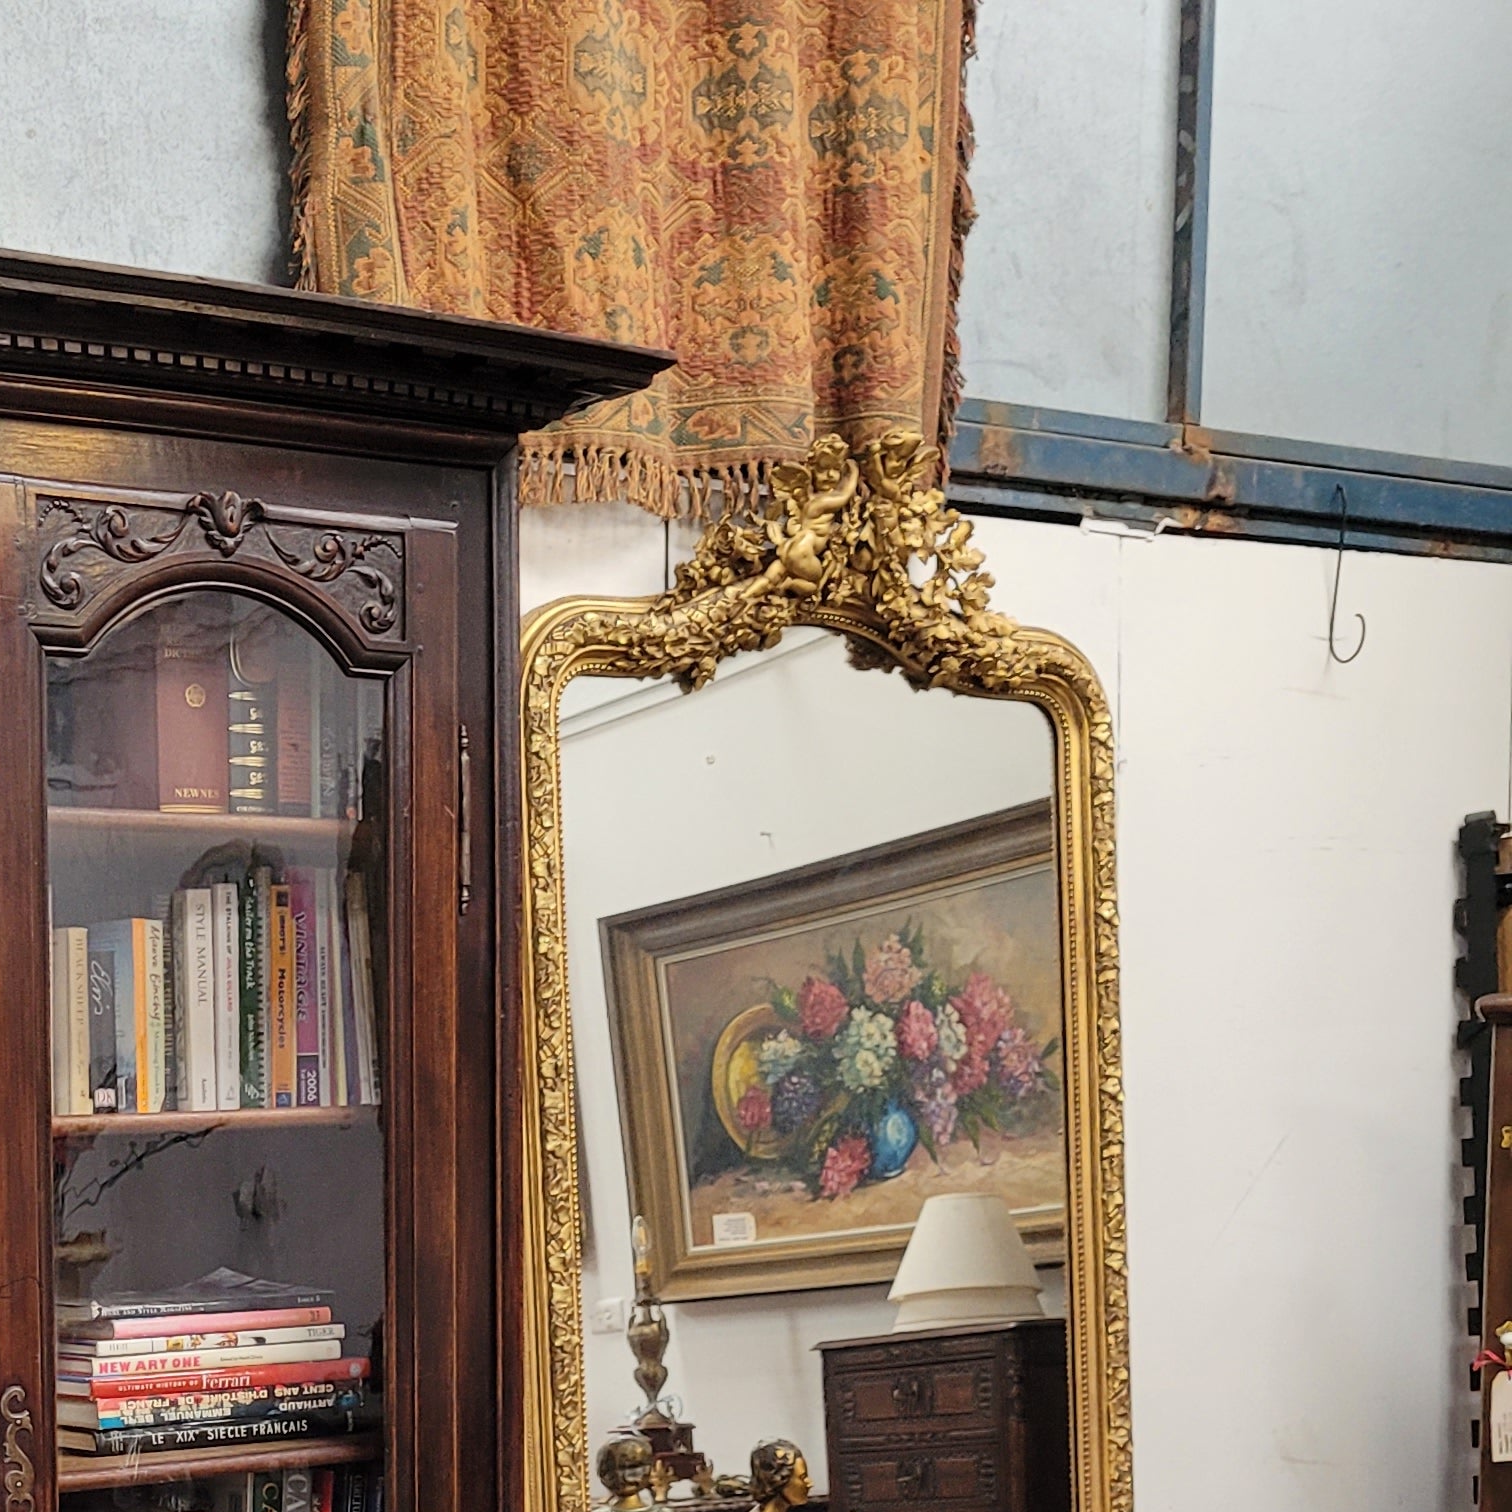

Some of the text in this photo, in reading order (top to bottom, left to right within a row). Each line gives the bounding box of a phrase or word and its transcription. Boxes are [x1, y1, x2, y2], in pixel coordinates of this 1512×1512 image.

[195, 904, 208, 1006] STYLE MANUAL
[226, 945, 232, 954] OF
[149, 926, 161, 1021] Maeve Binchy
[277, 968, 287, 1049] Motorcycles
[306, 1070, 317, 1102] 2006
[306, 1327, 335, 1337] TIGER
[98, 1356, 201, 1374] NEW ART ONE
[118, 1374, 252, 1392] ULTIMATE HISTORY OF Ferrari
[302, 1383, 335, 1395] CENT
[275, 1386, 299, 1397] ANS
[119, 1398, 170, 1410] FRANCE
[177, 1396, 195, 1405] DE
[279, 1398, 335, 1411] ARTHAUD
[160, 1406, 232, 1421] EMMANUEL
[152, 1433, 165, 1445] LE
[253, 1420, 308, 1436] FRANÇAIS
